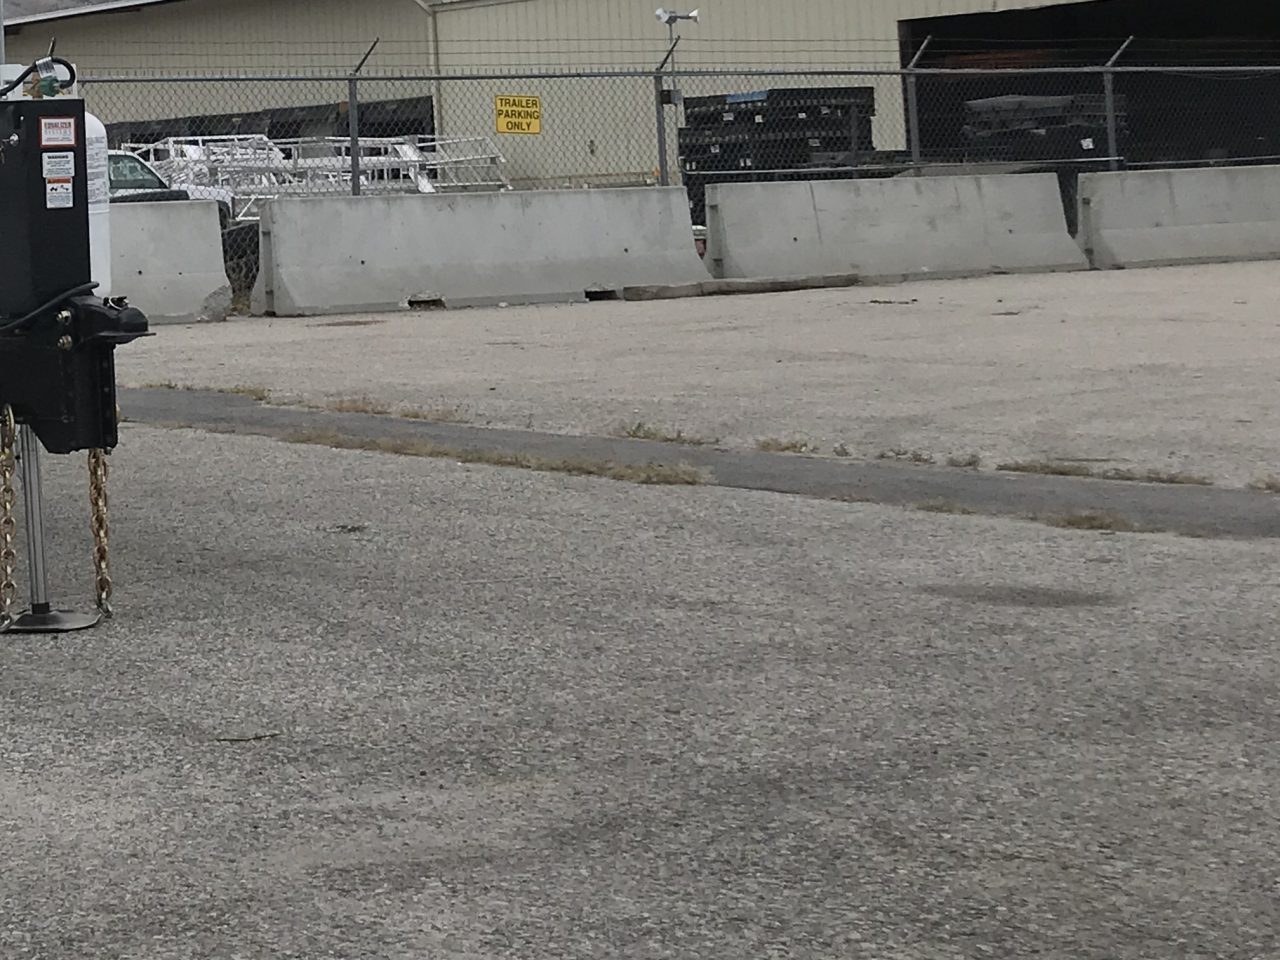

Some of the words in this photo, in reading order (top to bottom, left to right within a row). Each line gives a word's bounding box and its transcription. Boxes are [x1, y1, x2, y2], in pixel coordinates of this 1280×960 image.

[498, 98, 538, 108] TRAILER
[497, 109, 539, 120] PARKING
[506, 121, 532, 131] ONLY
